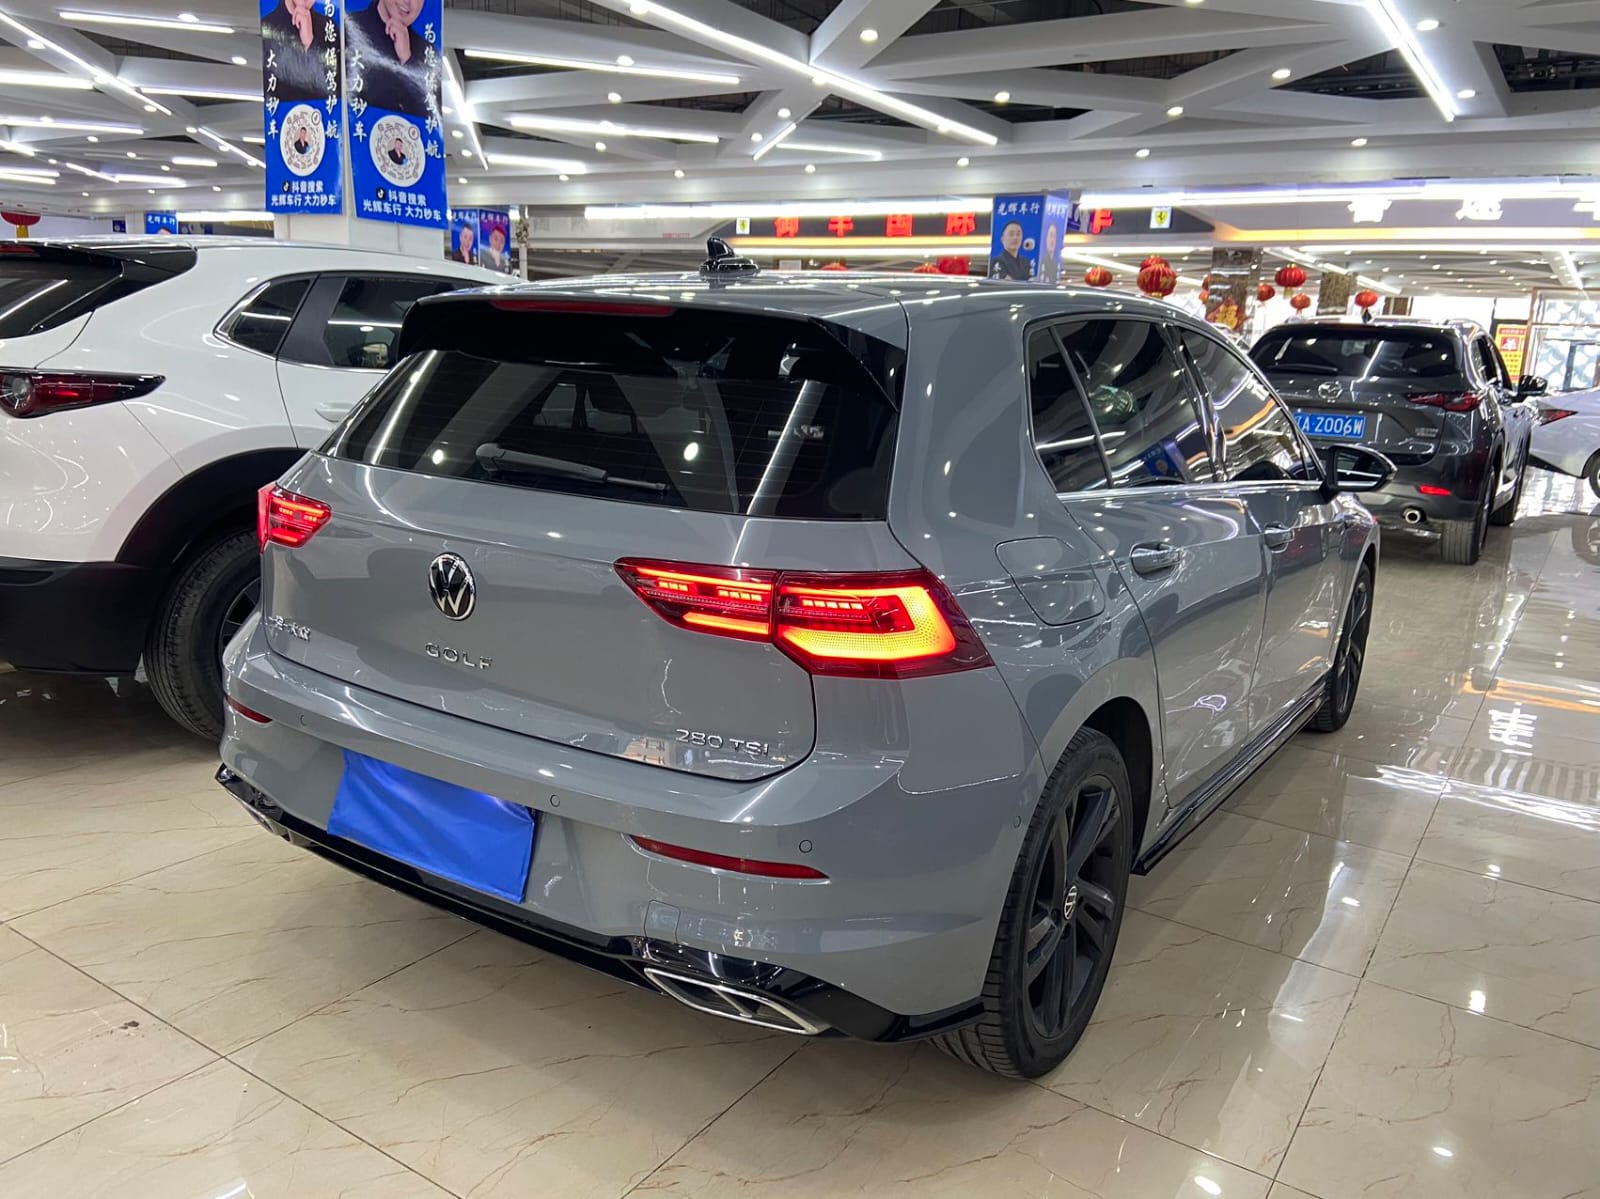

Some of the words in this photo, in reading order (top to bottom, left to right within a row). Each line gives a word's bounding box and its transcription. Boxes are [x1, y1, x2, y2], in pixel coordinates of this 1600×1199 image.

[291, 180, 324, 193] 抖音搜索
[388, 189, 427, 207] 抖音搜索
[425, 642, 493, 670] GOLF
[676, 728, 723, 749] 280
[729, 738, 770, 756] TSI
